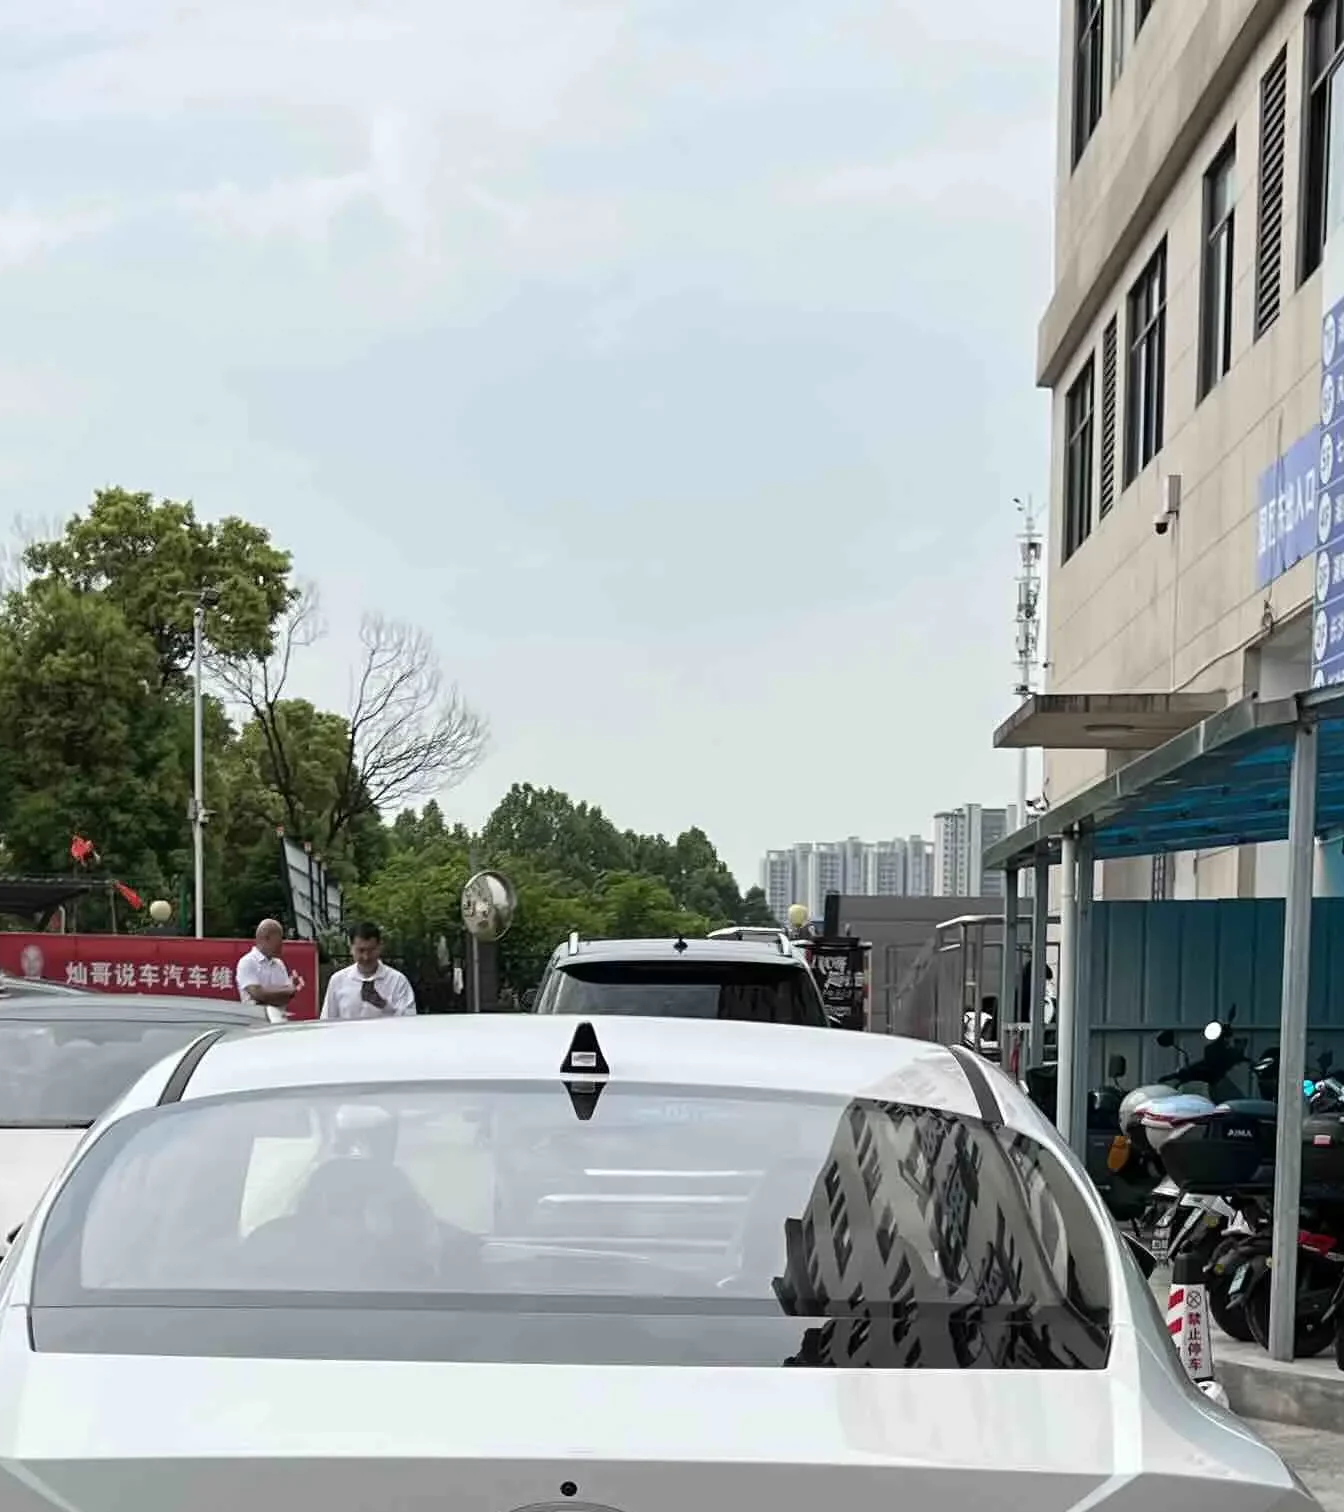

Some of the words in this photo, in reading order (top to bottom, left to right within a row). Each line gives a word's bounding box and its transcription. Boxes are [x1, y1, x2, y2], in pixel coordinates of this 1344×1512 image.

[66, 962, 305, 990] 灿哥说车汽车维
